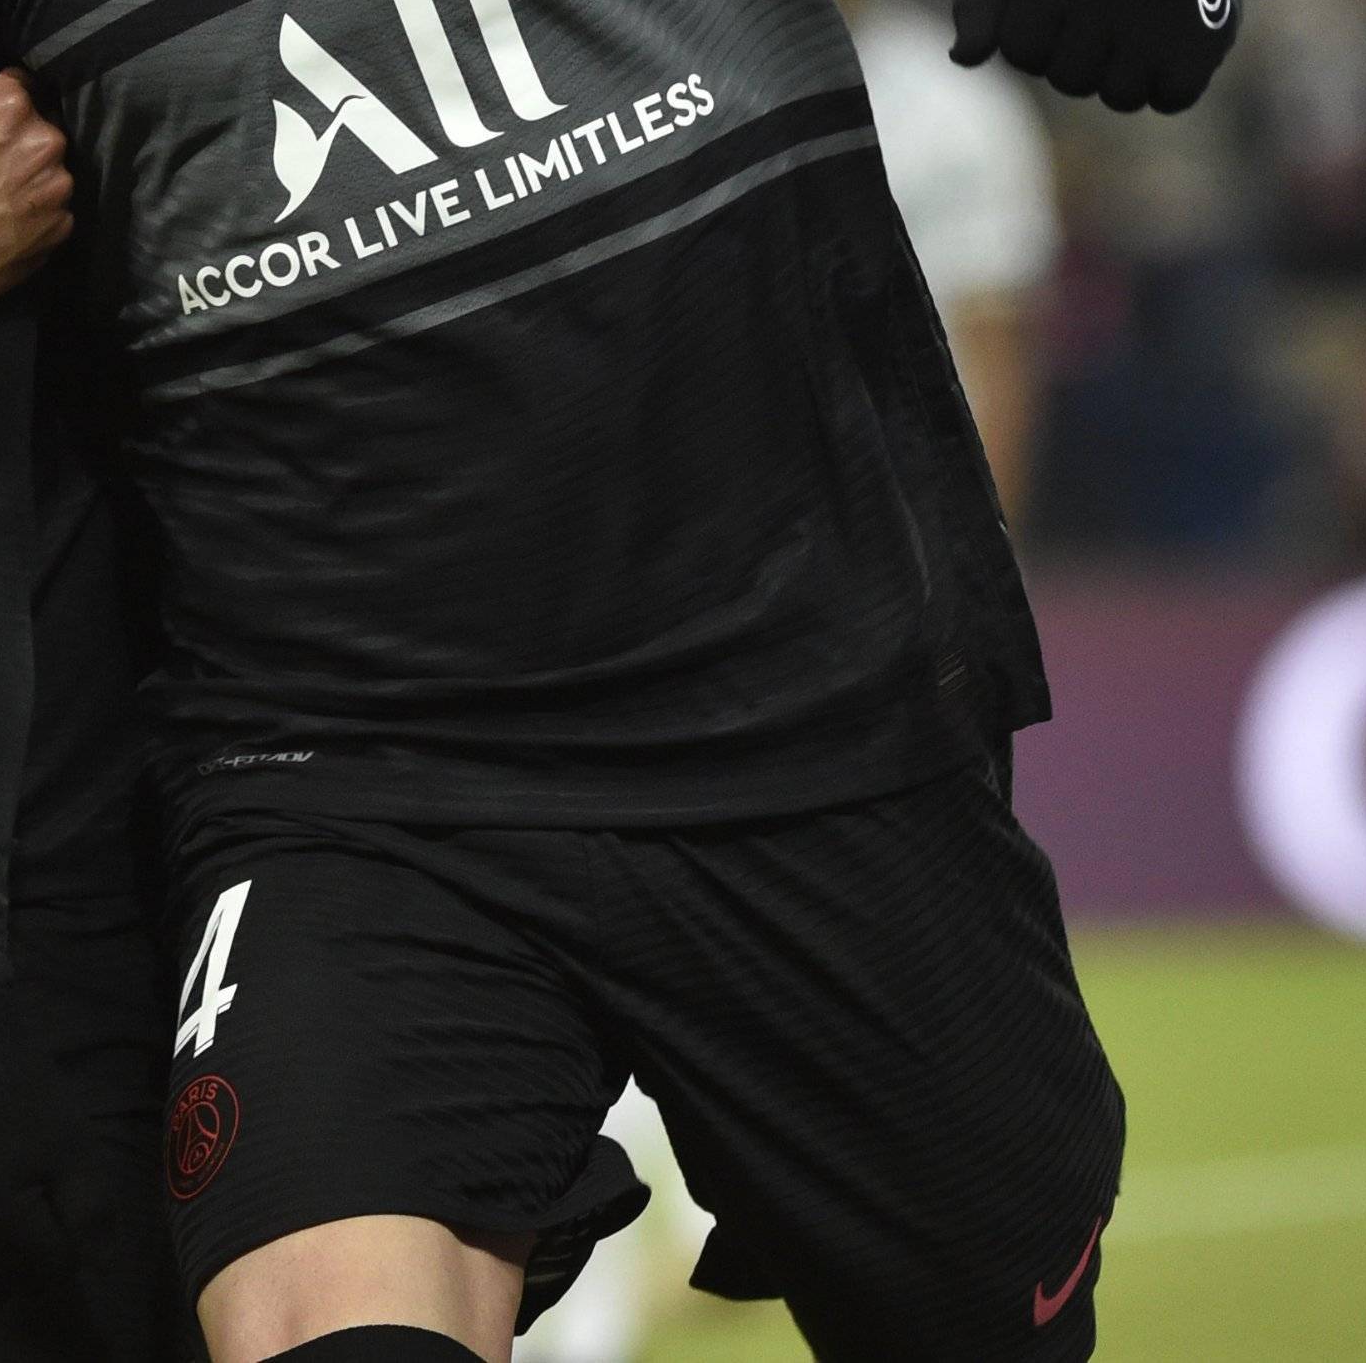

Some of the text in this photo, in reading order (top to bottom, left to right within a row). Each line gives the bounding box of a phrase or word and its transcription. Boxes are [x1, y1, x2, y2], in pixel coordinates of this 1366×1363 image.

[177, 73, 715, 316] ACCOR LIVE LIMITLESS
[172, 879, 252, 1059] 4
